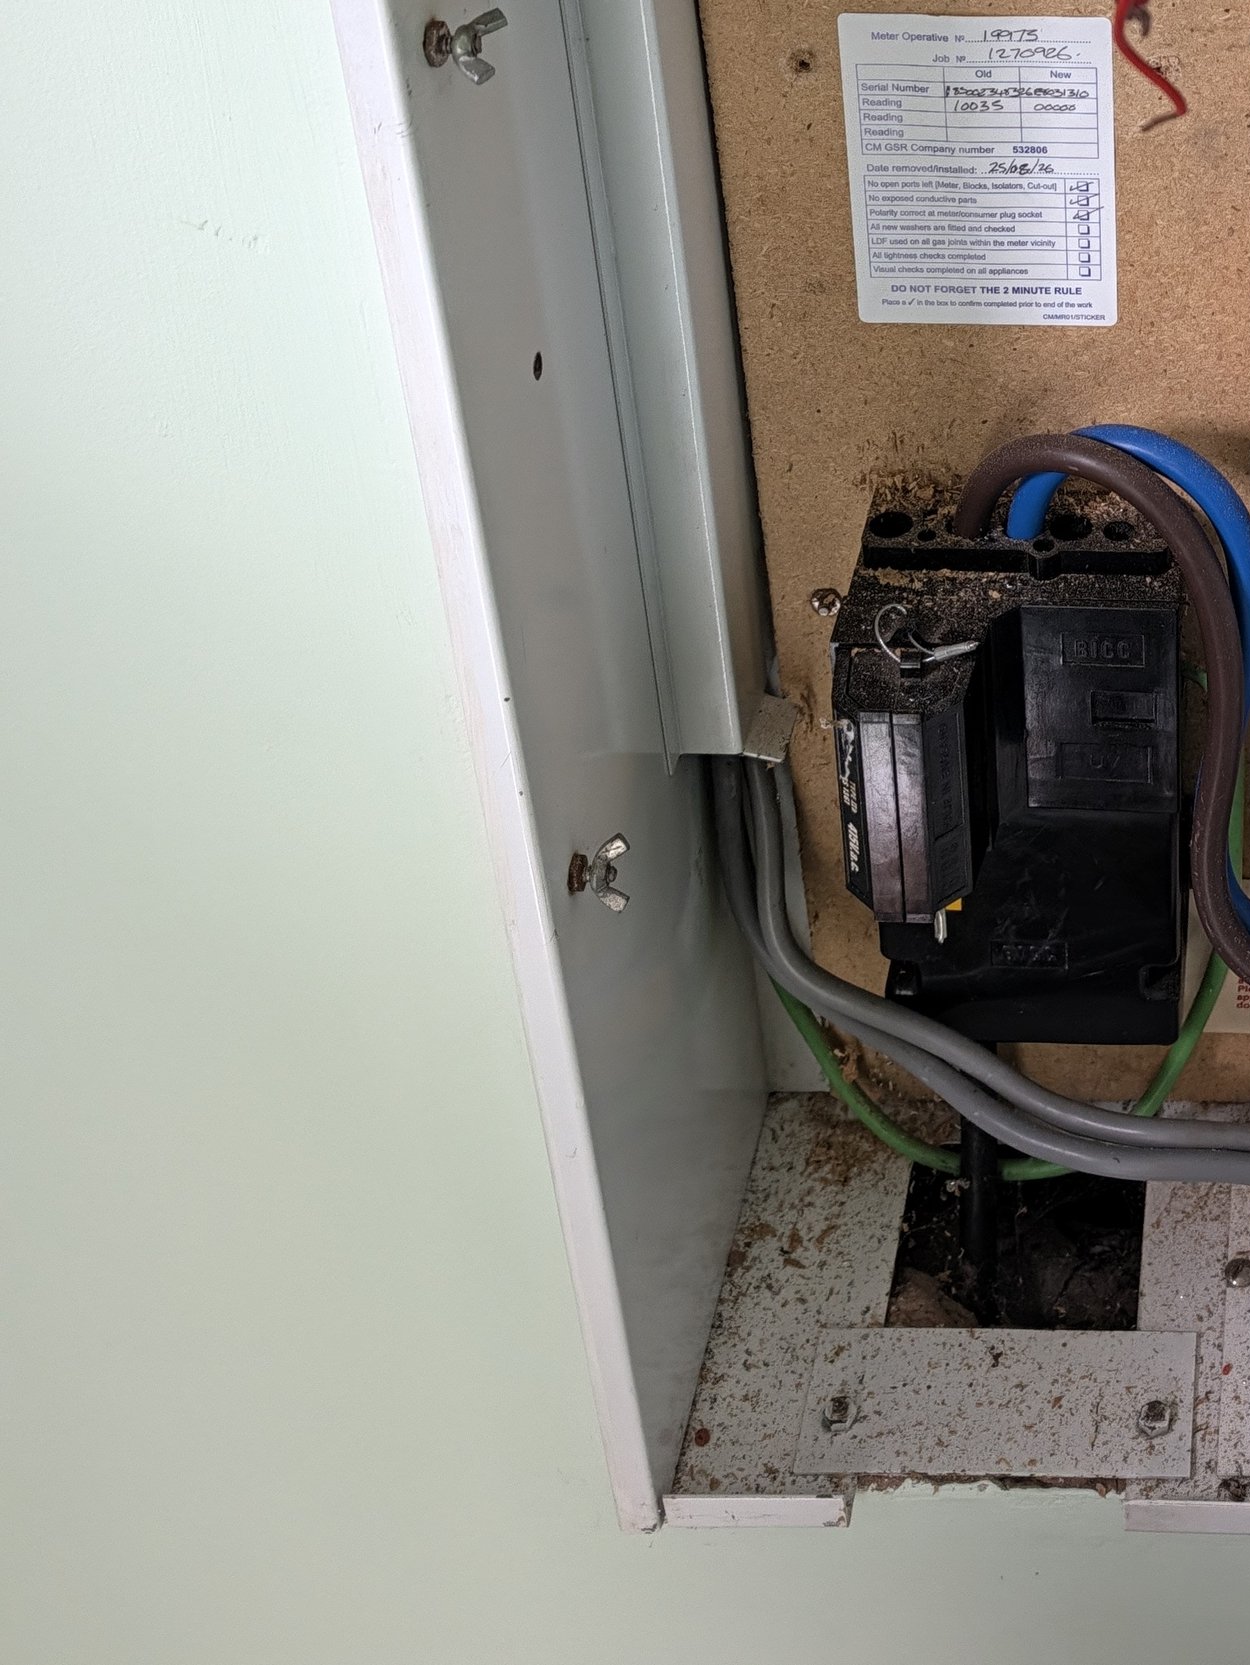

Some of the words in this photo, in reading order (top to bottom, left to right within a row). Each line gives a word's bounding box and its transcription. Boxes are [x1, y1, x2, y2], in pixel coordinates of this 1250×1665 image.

[871, 31, 899, 41] Meter
[902, 31, 949, 42] Operative
[932, 54, 950, 63] Job
[975, 70, 992, 78] Old
[1050, 70, 1072, 79] New
[861, 83, 889, 92] Serial
[892, 84, 930, 93] Number
[862, 98, 902, 108] Reading
[863, 113, 903, 123] Reading
[864, 128, 904, 138] Reading
[865, 143, 882, 151] CM
[885, 143, 908, 152] GSR
[911, 144, 956, 155] Company
[959, 145, 995, 154] number
[1012, 146, 1048, 154] 532806
[866, 164, 889, 172] Date
[892, 164, 977, 174] removed/installed:
[868, 180, 879, 188] No
[880, 181, 899, 189] open
[901, 181, 920, 189] ports
[921, 180, 933, 188] left
[881, 195, 914, 203] exposed
[869, 209, 898, 218] Polarity
[1000, 211, 1016, 219] plug
[870, 223, 880, 231] All
[947, 224, 966, 232] fitted
[968, 224, 982, 232] and
[984, 225, 1016, 233] checked
[932, 239, 946, 247] gas
[947, 239, 968, 247] joints
[1030, 240, 1056, 248] vicinity
[884, 252, 918, 260] tightness
[920, 252, 946, 260] checks
[947, 253, 987, 261] completed
[873, 265, 897, 273] Visual
[926, 266, 965, 275] completed
[909, 285, 932, 293] NOT
[934, 285, 977, 294] FORGET
[980, 286, 1001, 294] THE
[1003, 286, 1010, 294] 2
[1012, 287, 1052, 295] MINUTE
[1054, 287, 1082, 295] RULE
[882, 298, 901, 306] Place
[1074, 639, 1131, 658] BICC
